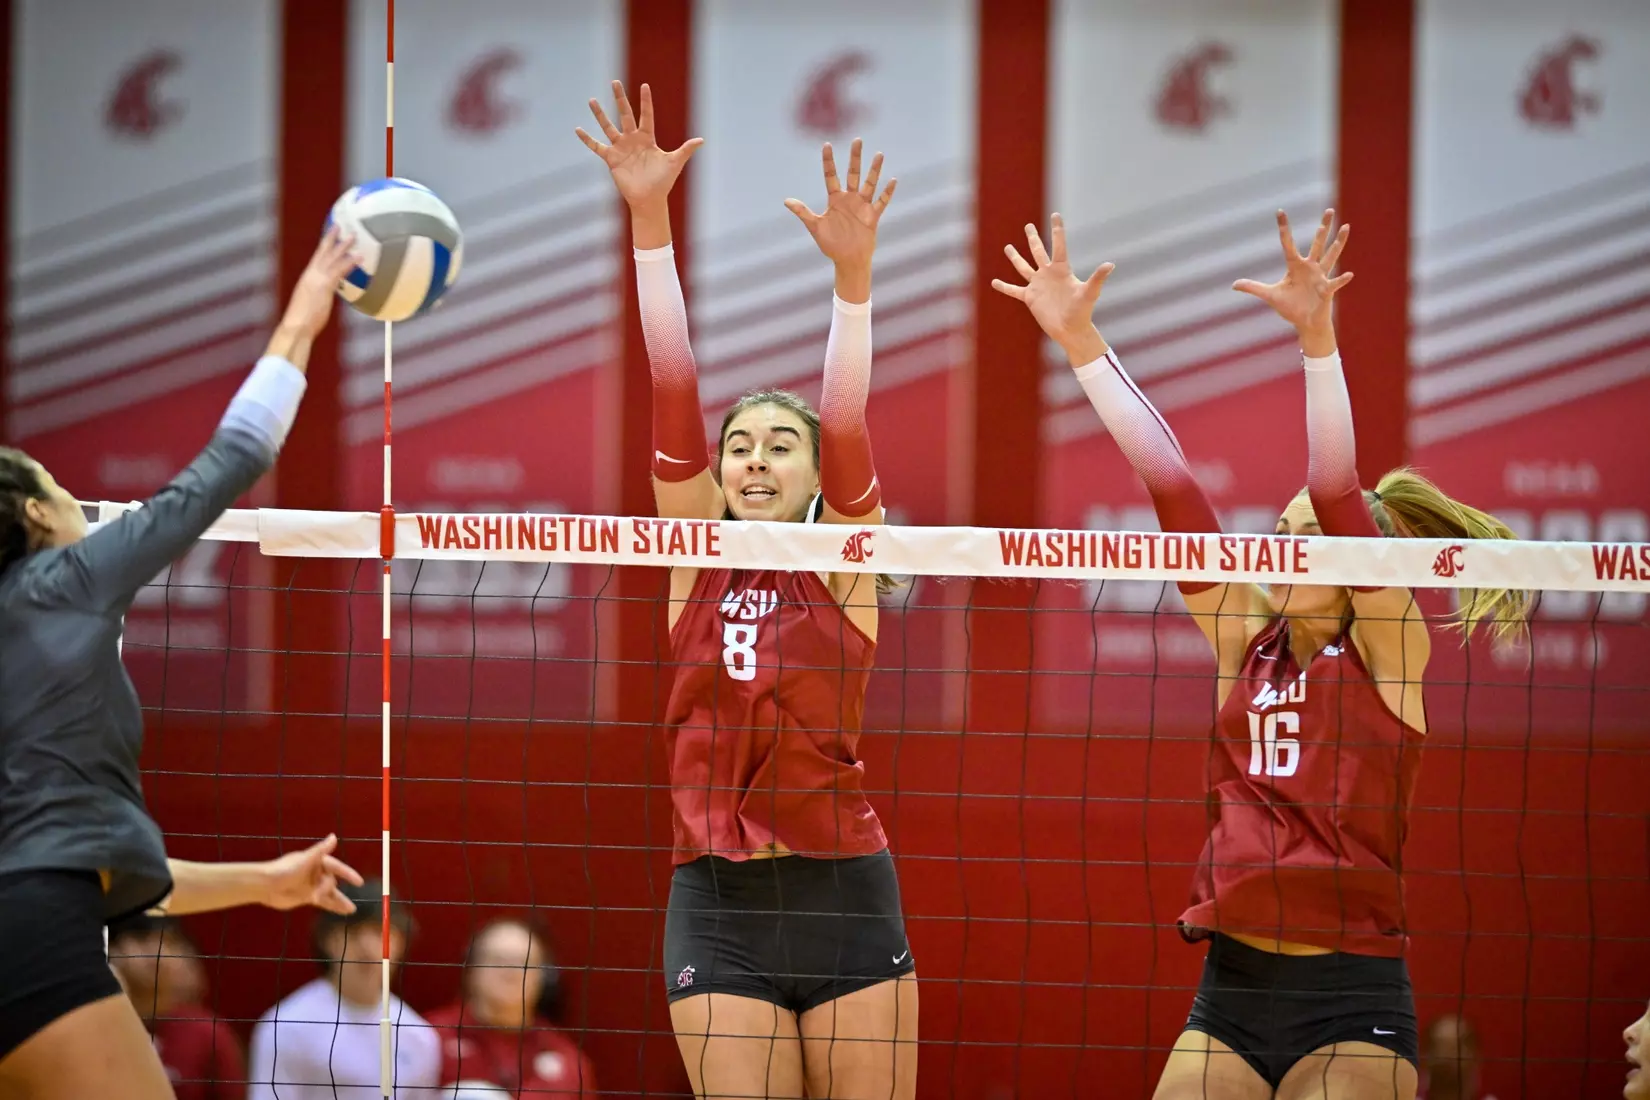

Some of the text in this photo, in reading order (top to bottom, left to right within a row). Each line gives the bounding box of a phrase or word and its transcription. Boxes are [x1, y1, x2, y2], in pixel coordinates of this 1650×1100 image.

[416, 514, 721, 556] WASHINGTON STATE
[998, 530, 1309, 573] WASHINGTON STATE
[723, 621, 758, 681] 8
[1246, 710, 1300, 777] 16
